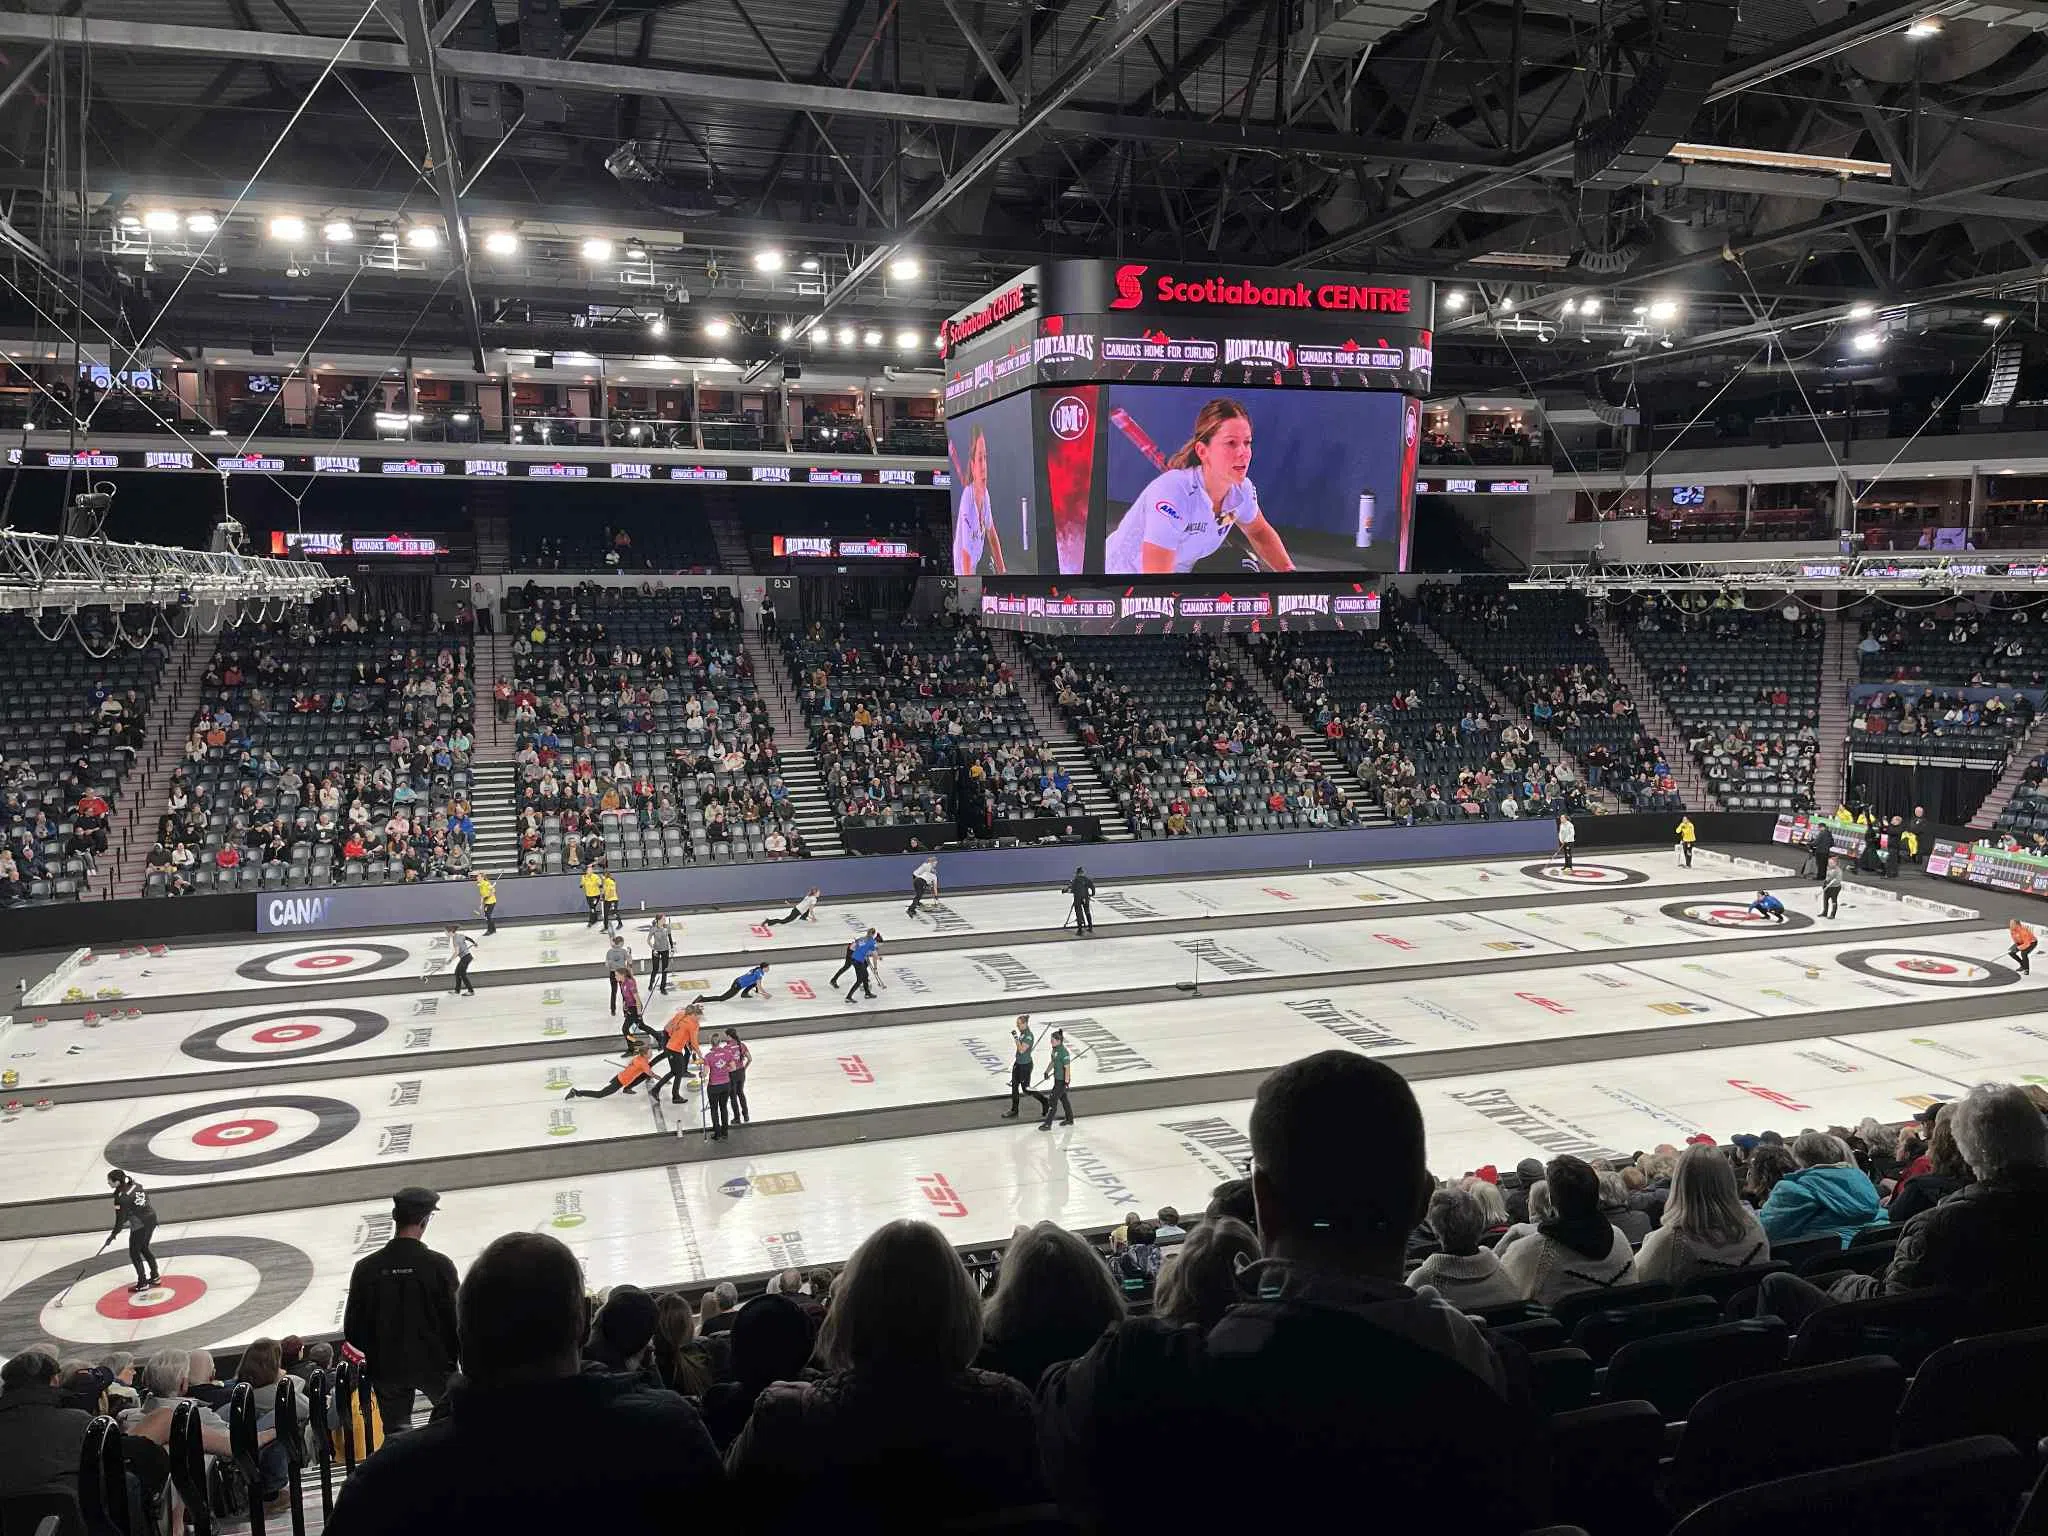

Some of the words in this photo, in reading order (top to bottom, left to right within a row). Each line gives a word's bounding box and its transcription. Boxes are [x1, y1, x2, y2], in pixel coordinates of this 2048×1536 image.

[992, 283, 1025, 320] CENTRE
[1158, 275, 1312, 308] Scotiabank
[1317, 284, 1410, 312] CENTRE
[1034, 335, 1094, 364] MONTANA'S
[1106, 344, 1142, 357] CANADA'S
[1144, 345, 1165, 358] HOME
[1167, 346, 1183, 358] FOR
[1184, 346, 1215, 359] CURLING
[1224, 339, 1291, 367] MONTANA'S
[1300, 350, 1333, 364] CANADA'S
[1335, 352, 1355, 364] HOME
[1356, 353, 1370, 365] FOR
[1372, 353, 1401, 366] CURLING
[145, 452, 194, 469] MONTANA'S
[314, 457, 360, 473] MONTANA'S
[465, 460, 508, 475] MONTANA'S
[611, 464, 651, 479] MONTANA'S
[752, 467, 790, 481] MONTANA'S
[880, 470, 915, 484] MONTANA'S
[355, 541, 384, 550] CANADA'S
[386, 542, 404, 551] HOME
[405, 542, 418, 551] FOR
[785, 538, 831, 554] MONTANA'S
[450, 579, 458, 589] 7
[774, 579, 781, 588] 8
[940, 579, 947, 588] 9
[1061, 603, 1077, 615] HOME
[1080, 603, 1094, 614] FOR
[1121, 598, 1175, 618] MONTANA'S
[1182, 602, 1213, 613] CANADA'S
[1216, 602, 1234, 613] HOME
[1238, 602, 1251, 612] FOR
[1278, 595, 1329, 615] MONTANA'S
[1336, 599, 1364, 610] CANADA'S
[1279, 998, 1416, 1050] MONTANA'S
[959, 1037, 1011, 1076] HALIFAX
[1068, 1148, 1140, 1206] HALIFAX
